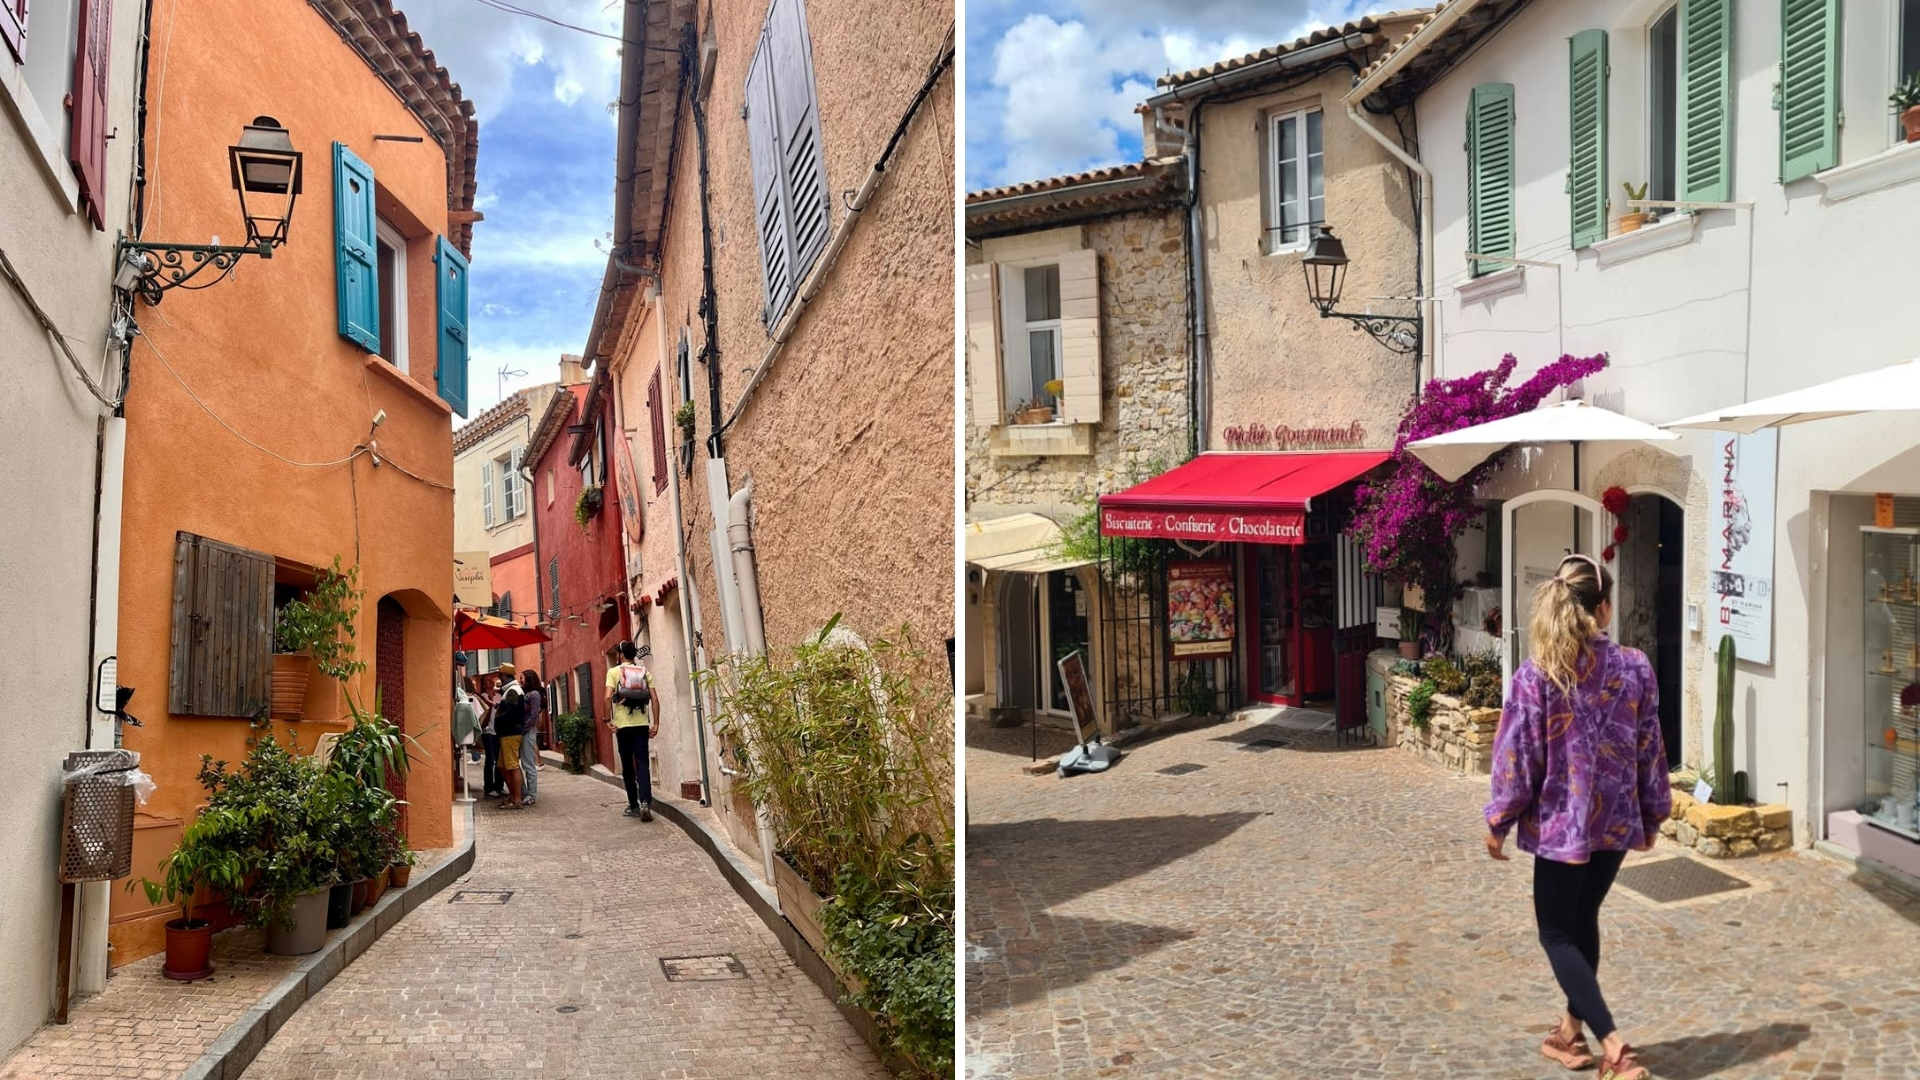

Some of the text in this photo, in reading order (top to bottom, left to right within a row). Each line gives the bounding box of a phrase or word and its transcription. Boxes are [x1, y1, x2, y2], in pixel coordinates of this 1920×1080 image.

[1105, 514, 1301, 537] Biscuiterie Confiserie Chocolaterie
[1721, 438, 1735, 571] MARINA
